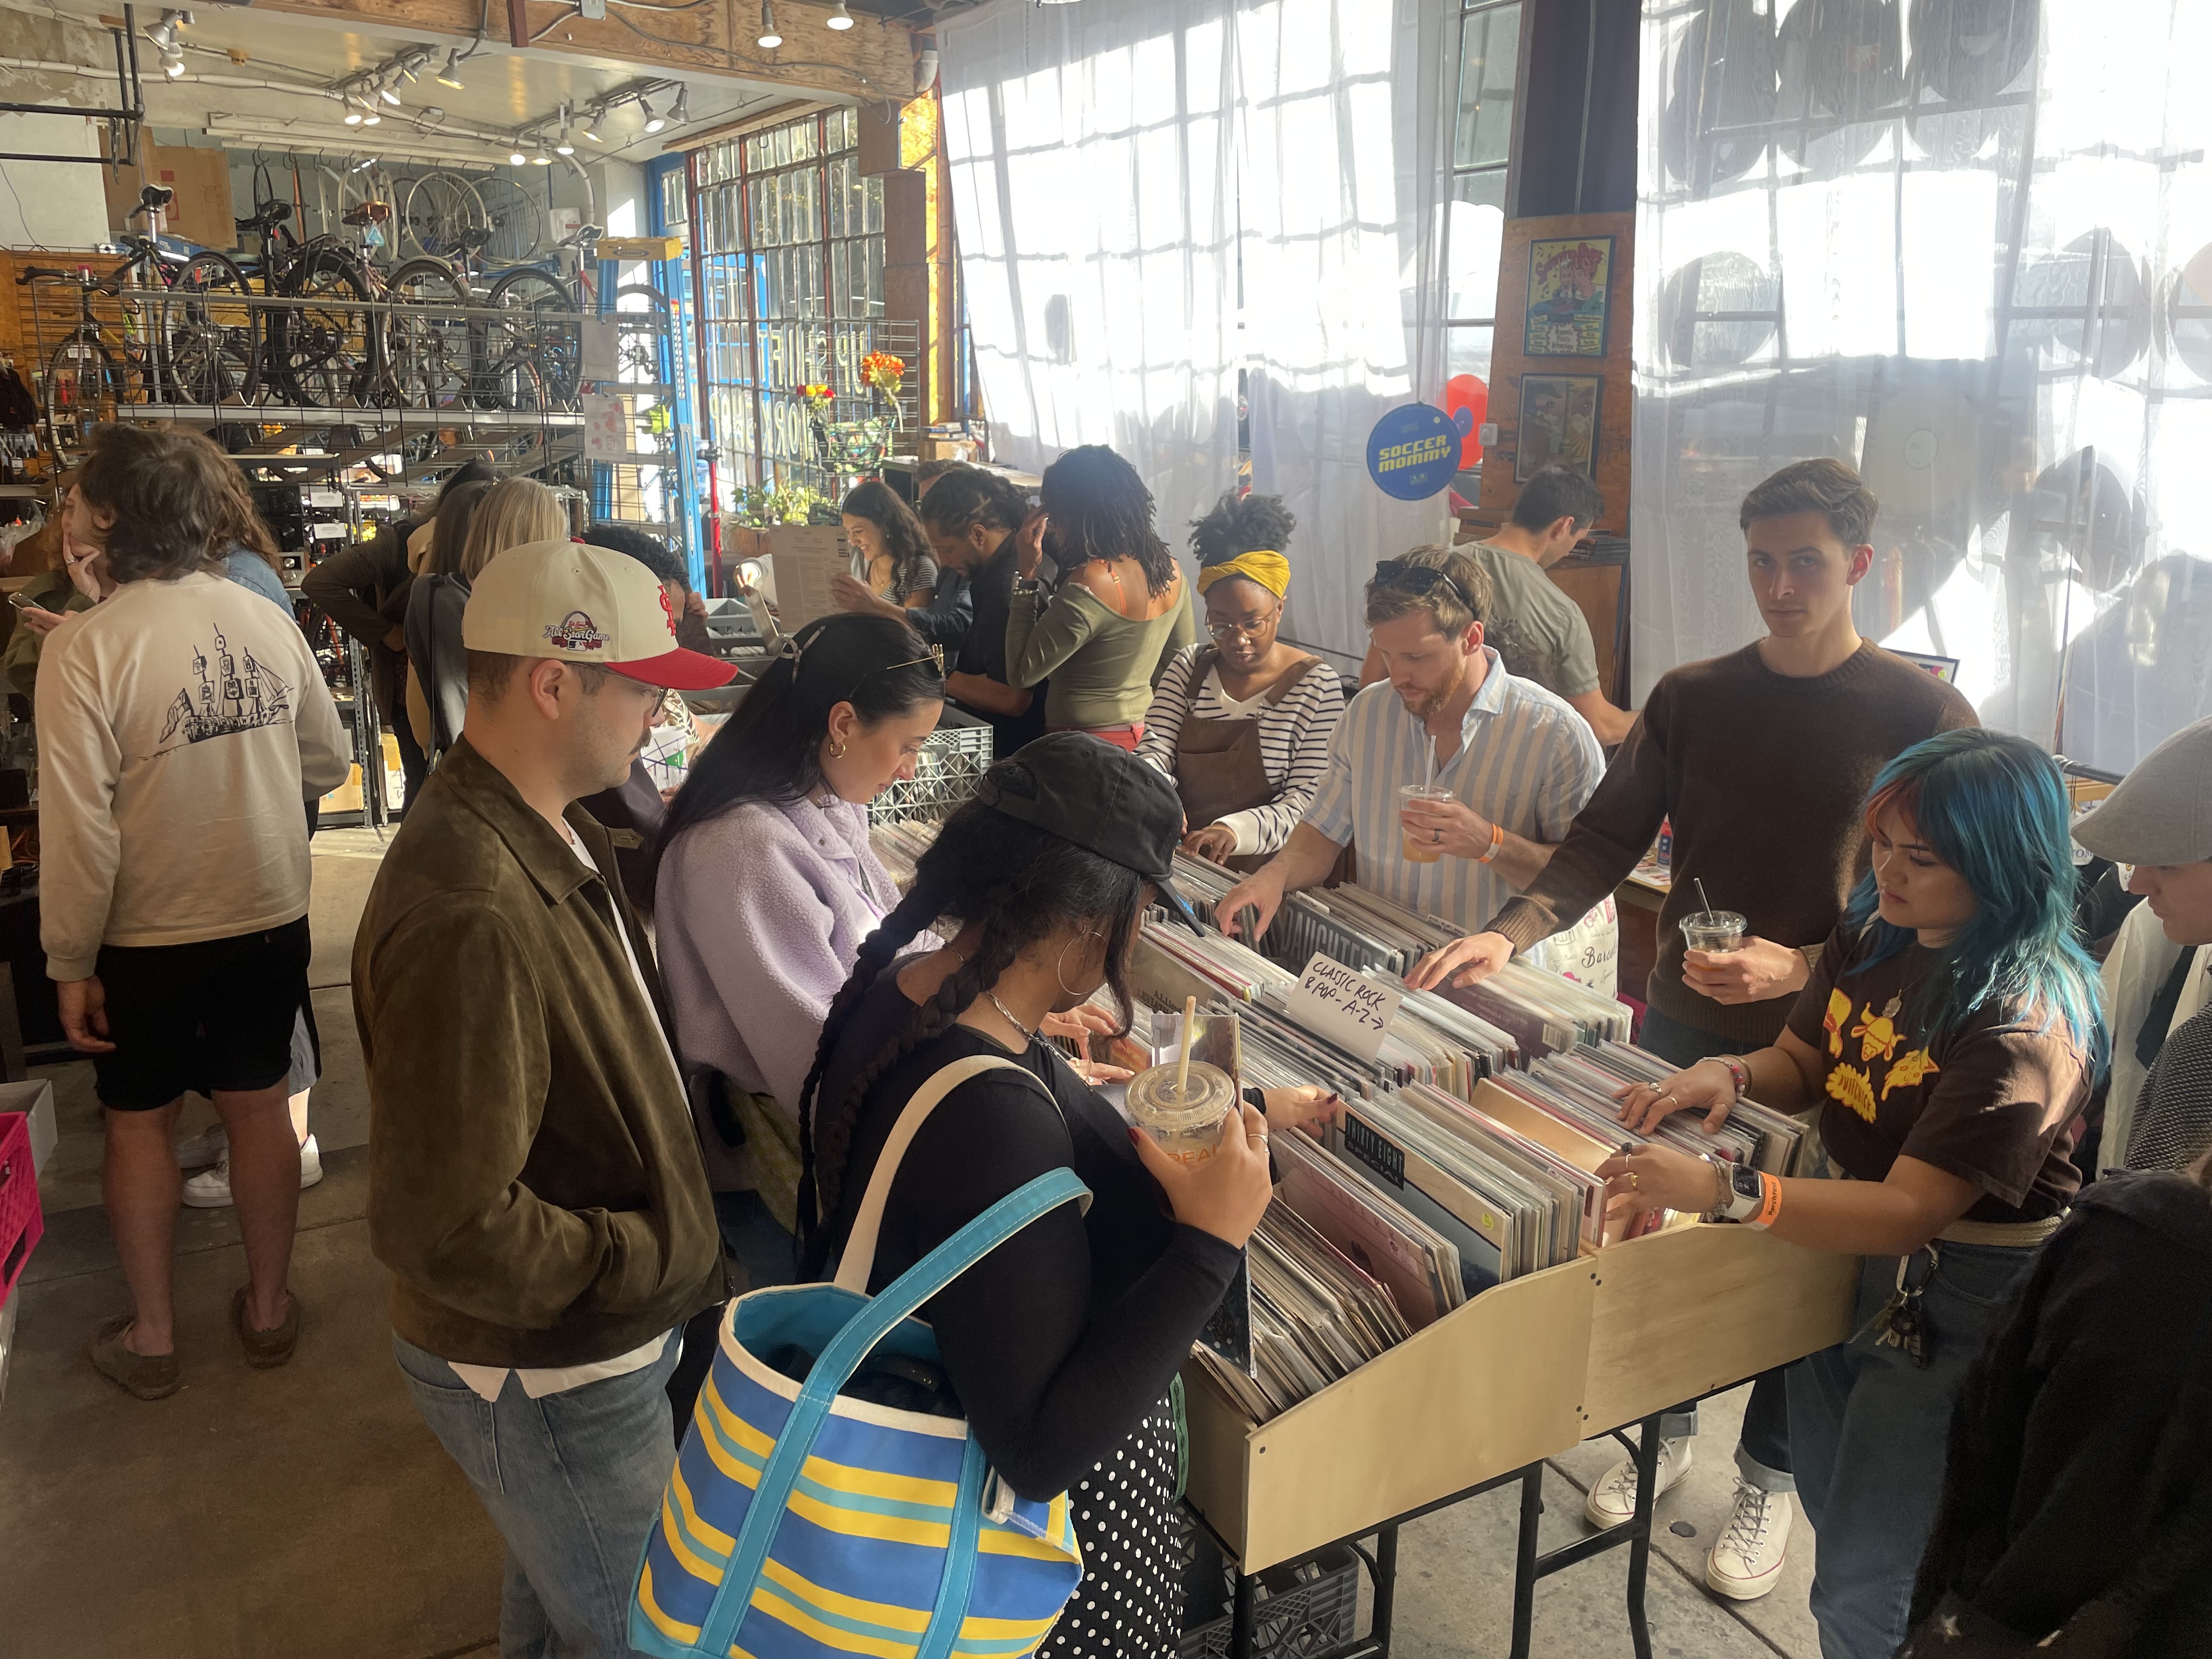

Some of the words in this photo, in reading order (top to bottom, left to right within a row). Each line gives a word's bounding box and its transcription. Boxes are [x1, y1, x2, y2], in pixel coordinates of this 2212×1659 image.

[1379, 435, 1447, 460] SOCCER
[1379, 446, 1451, 473] MOMMY
[544, 625, 563, 638] All
[563, 627, 586, 640] Star
[585, 629, 610, 642] Game
[1313, 962, 1356, 991] CLASSIC
[1354, 984, 1386, 1011] ROCK
[1342, 1000, 1370, 1024] A-Z
[1347, 1116, 1375, 1154] THIRTY
[1378, 1139, 1402, 1174] EIGHT
[1347, 1141, 1399, 1184] SPECIAL
